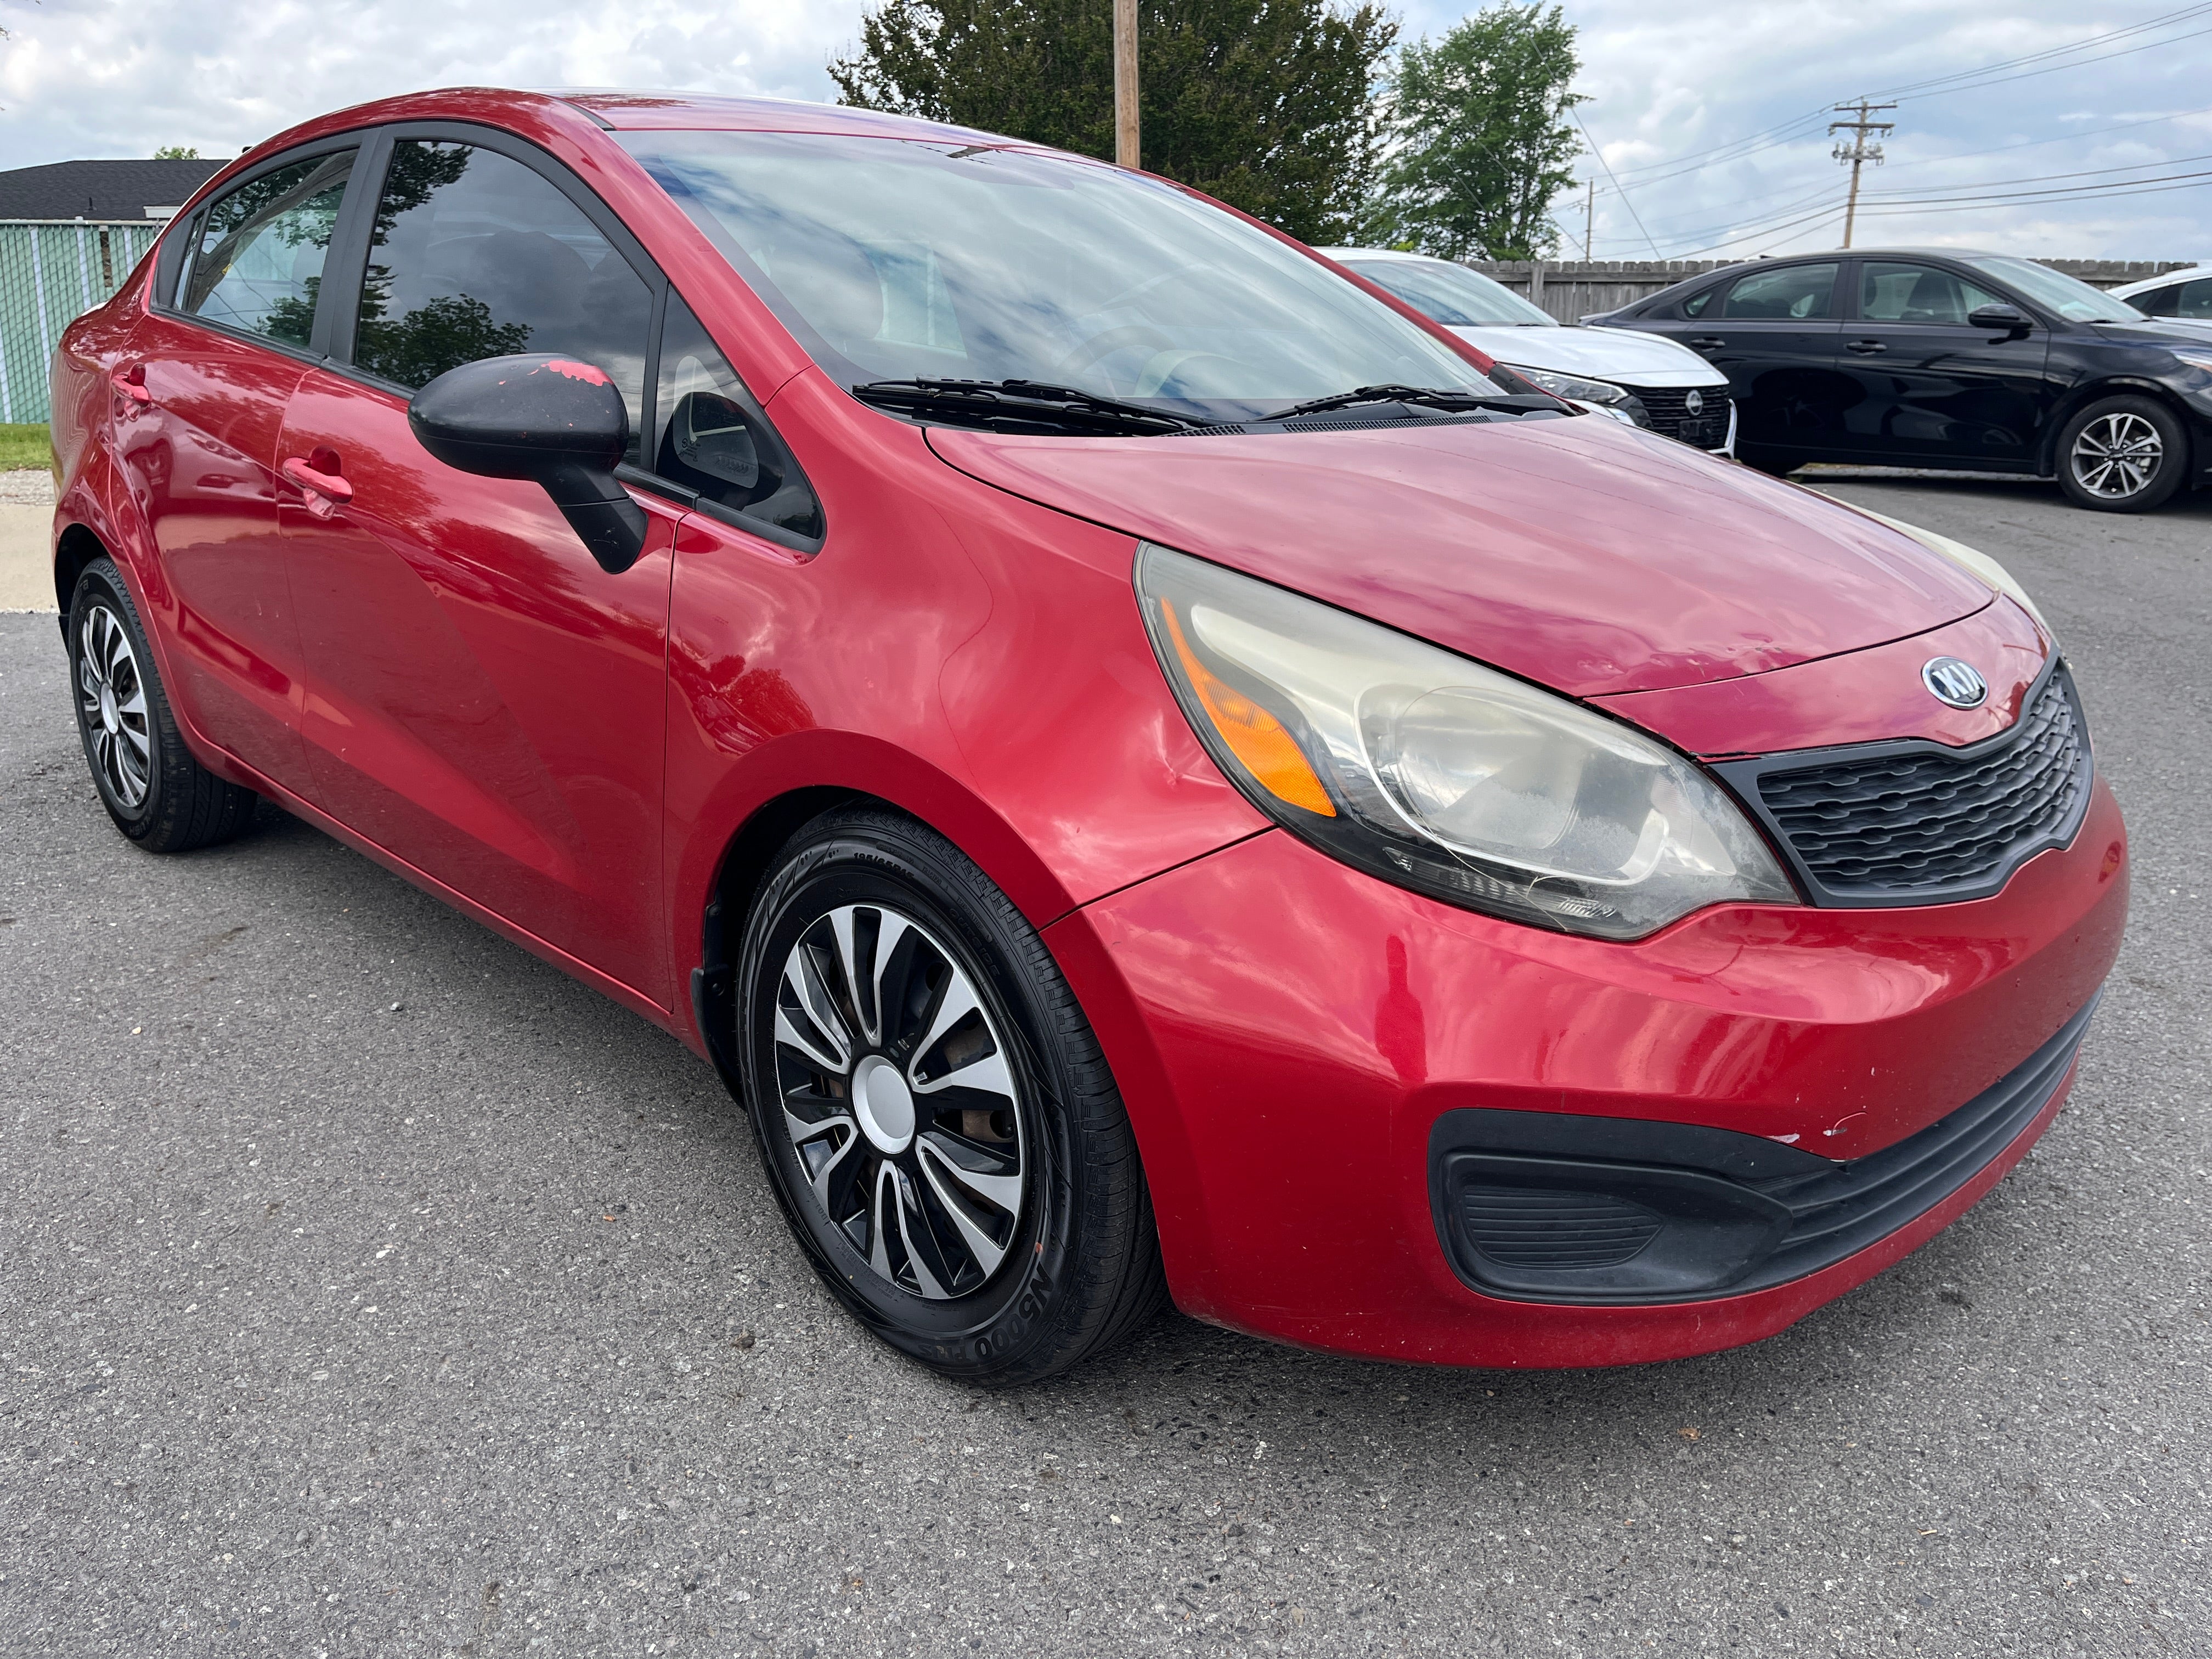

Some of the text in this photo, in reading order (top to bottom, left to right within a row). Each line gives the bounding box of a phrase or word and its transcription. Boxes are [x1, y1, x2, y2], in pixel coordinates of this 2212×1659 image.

[1931, 662, 1985, 699] KIA
[949, 908, 1001, 976] OUTSIDE
[918, 1261, 1054, 1362] N5000 PLUS
